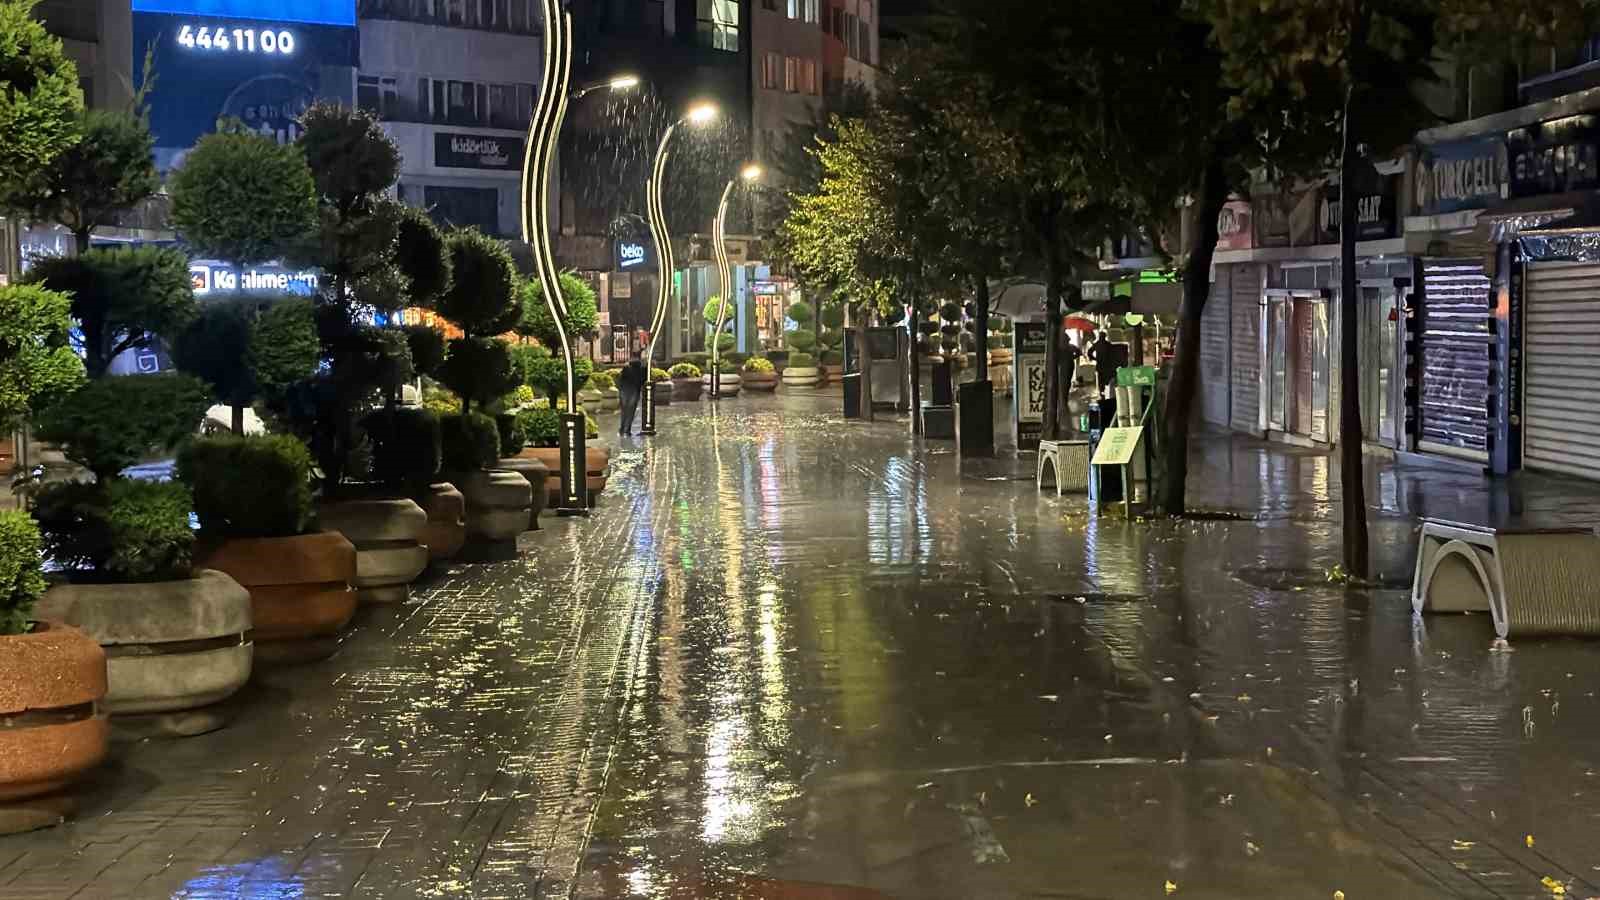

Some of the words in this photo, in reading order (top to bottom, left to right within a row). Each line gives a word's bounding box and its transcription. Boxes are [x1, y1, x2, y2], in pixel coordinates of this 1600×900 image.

[177, 24, 230, 51] 444
[232, 28, 255, 52] 11
[260, 30, 295, 54] 00
[620, 243, 644, 258] beko
